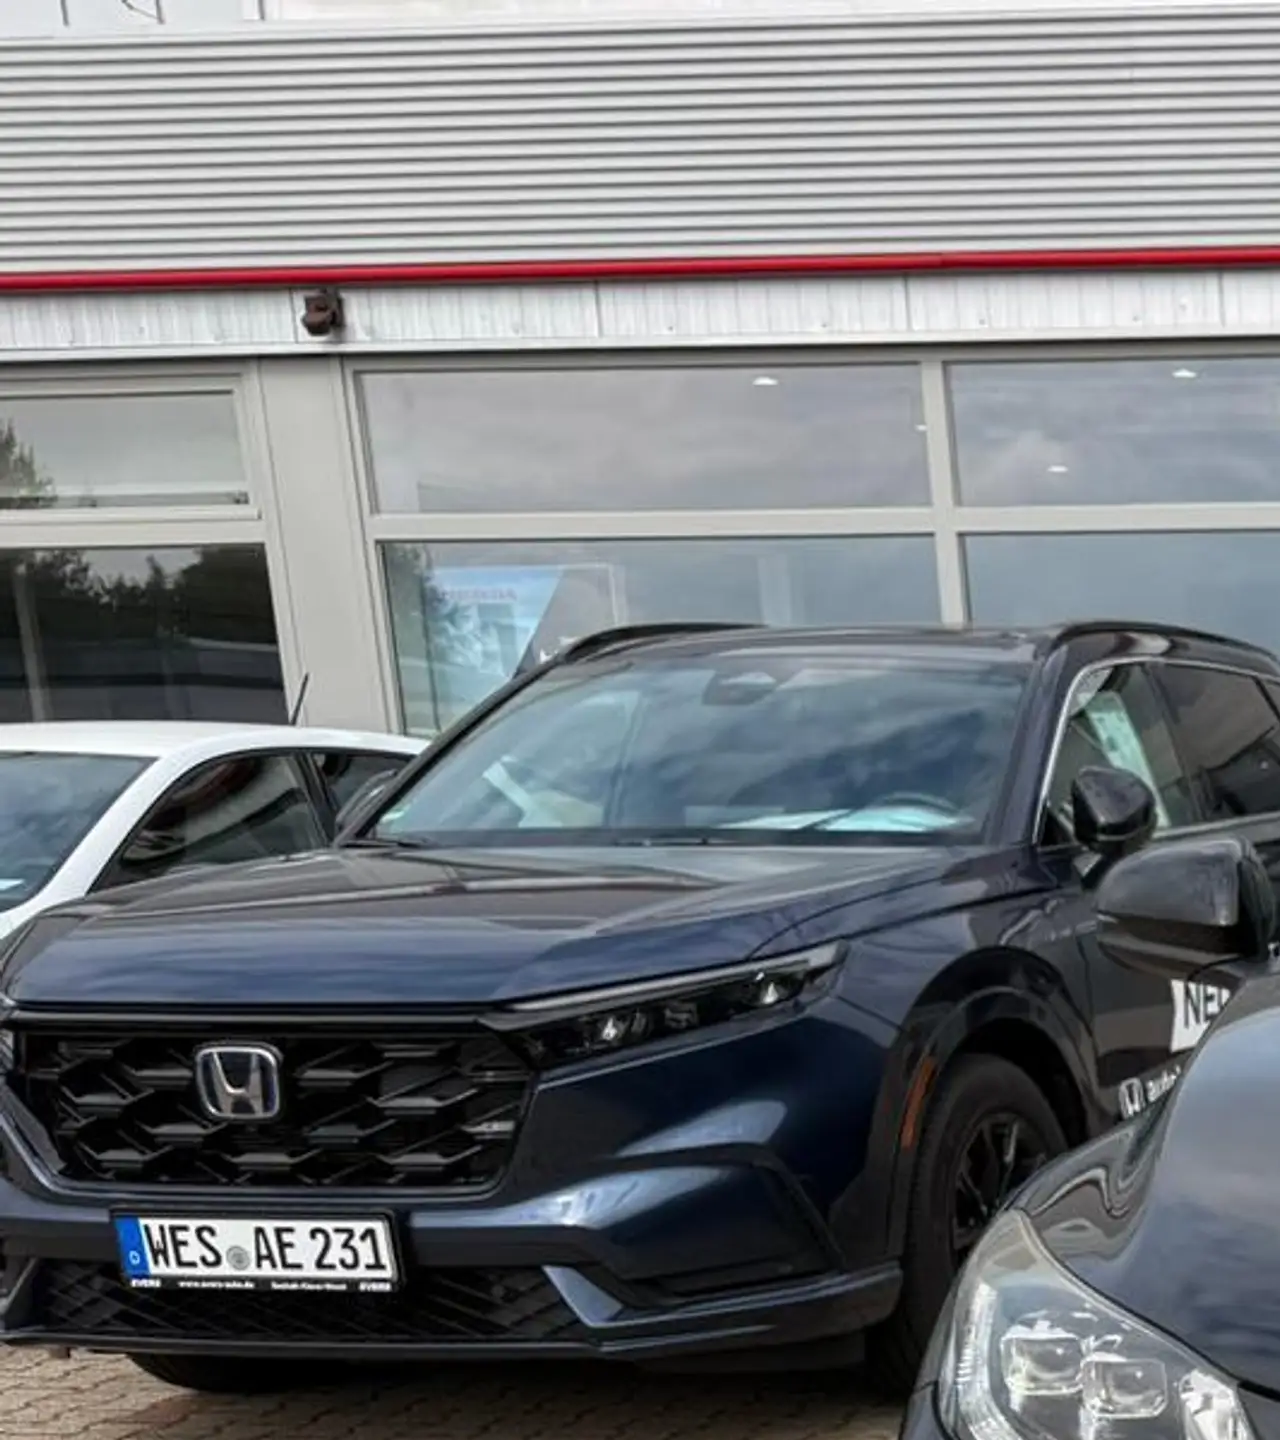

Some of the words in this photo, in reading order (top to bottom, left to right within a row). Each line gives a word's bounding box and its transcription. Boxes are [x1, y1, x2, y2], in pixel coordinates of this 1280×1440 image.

[143, 1223, 223, 1269] WES
[254, 1226, 303, 1269] AE
[309, 1227, 387, 1270] 231
